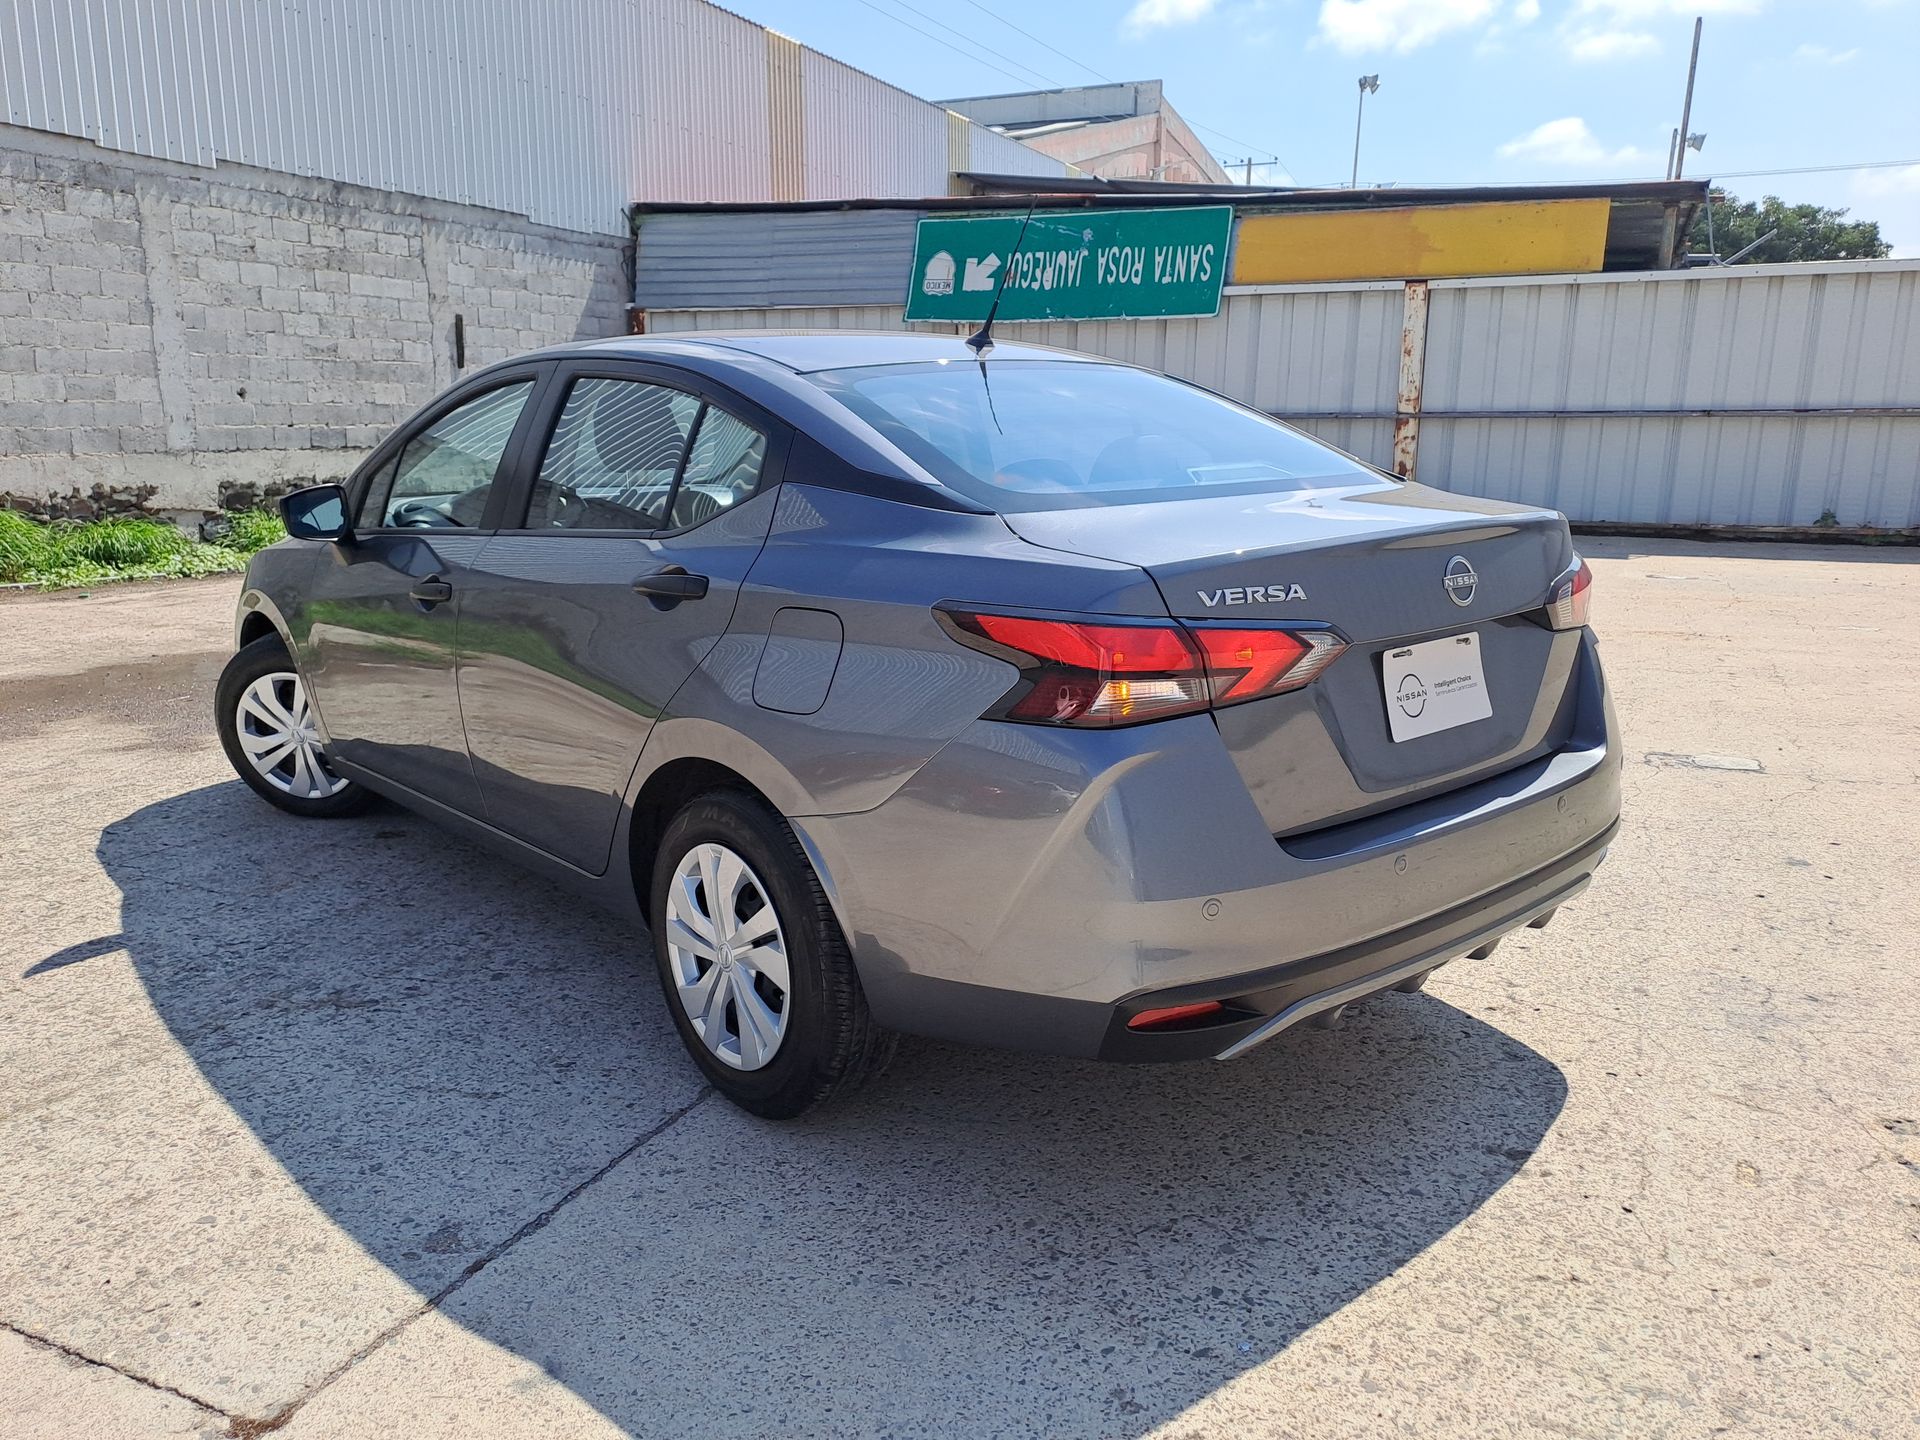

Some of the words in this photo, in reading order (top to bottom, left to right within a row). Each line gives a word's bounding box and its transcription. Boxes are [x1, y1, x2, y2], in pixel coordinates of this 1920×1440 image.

[1003, 249, 1089, 290] JAUREGUI
[1096, 246, 1146, 285] ROSA
[1154, 244, 1214, 284] SANTA
[1197, 583, 1307, 608] VERSA
[1442, 574, 1479, 589] NISSAN
[1396, 688, 1428, 703] NISSAN
